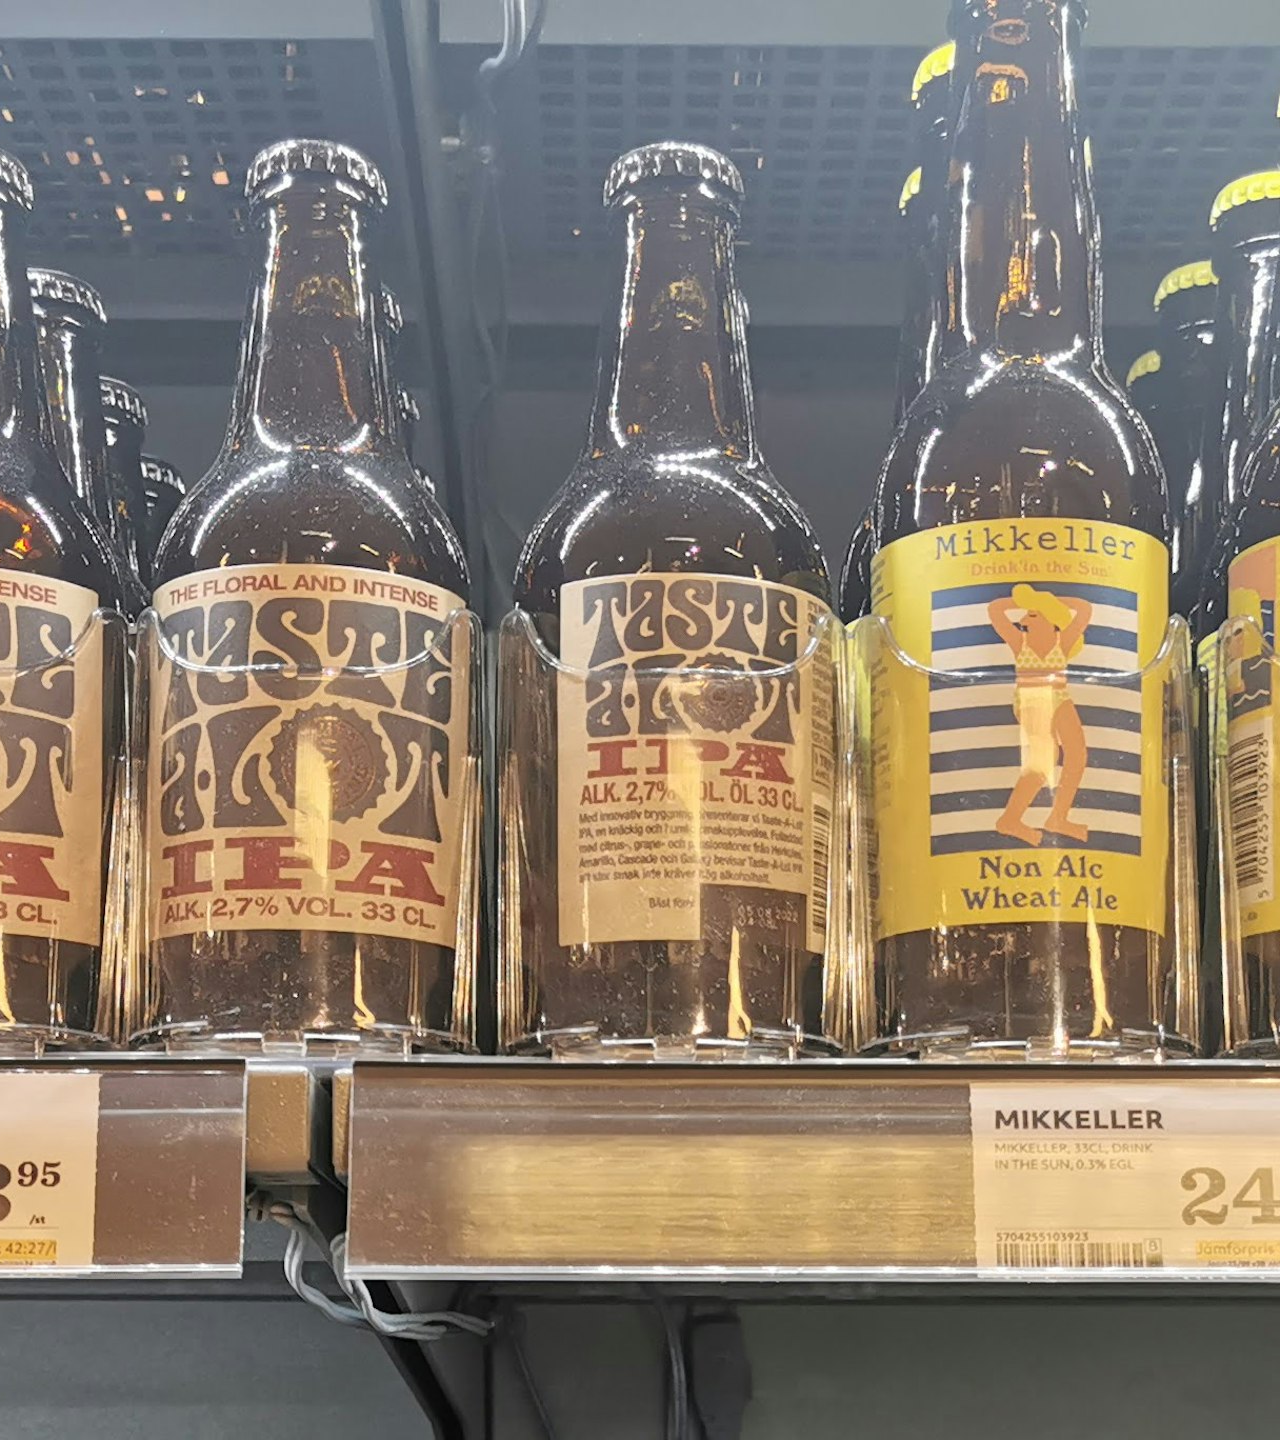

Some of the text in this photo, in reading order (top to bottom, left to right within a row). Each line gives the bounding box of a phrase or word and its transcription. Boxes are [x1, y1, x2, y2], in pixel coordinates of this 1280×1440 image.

[935, 527, 1137, 560] Mikkeller
[169, 575, 438, 611] THE FLORAL AND INTENSE
[587, 739, 795, 784] IPA
[579, 779, 803, 812] ALK. 2,7% ÖL 33 CL.
[162, 836, 445, 906] IPA
[979, 855, 1104, 880] Non Alc
[961, 885, 1118, 910] Wheat Ale
[16, 904, 58, 925] CL.
[165, 896, 436, 930] ALK. 2,7% VOL. 33 CL.
[994, 1110, 1164, 1130] MIKKELLER
[994, 1143, 1154, 1154] MIKKELLER, 33CL, DRINK
[17, 1161, 61, 1186] 95
[994, 1159, 1135, 1171] IN THE SUN, EGL
